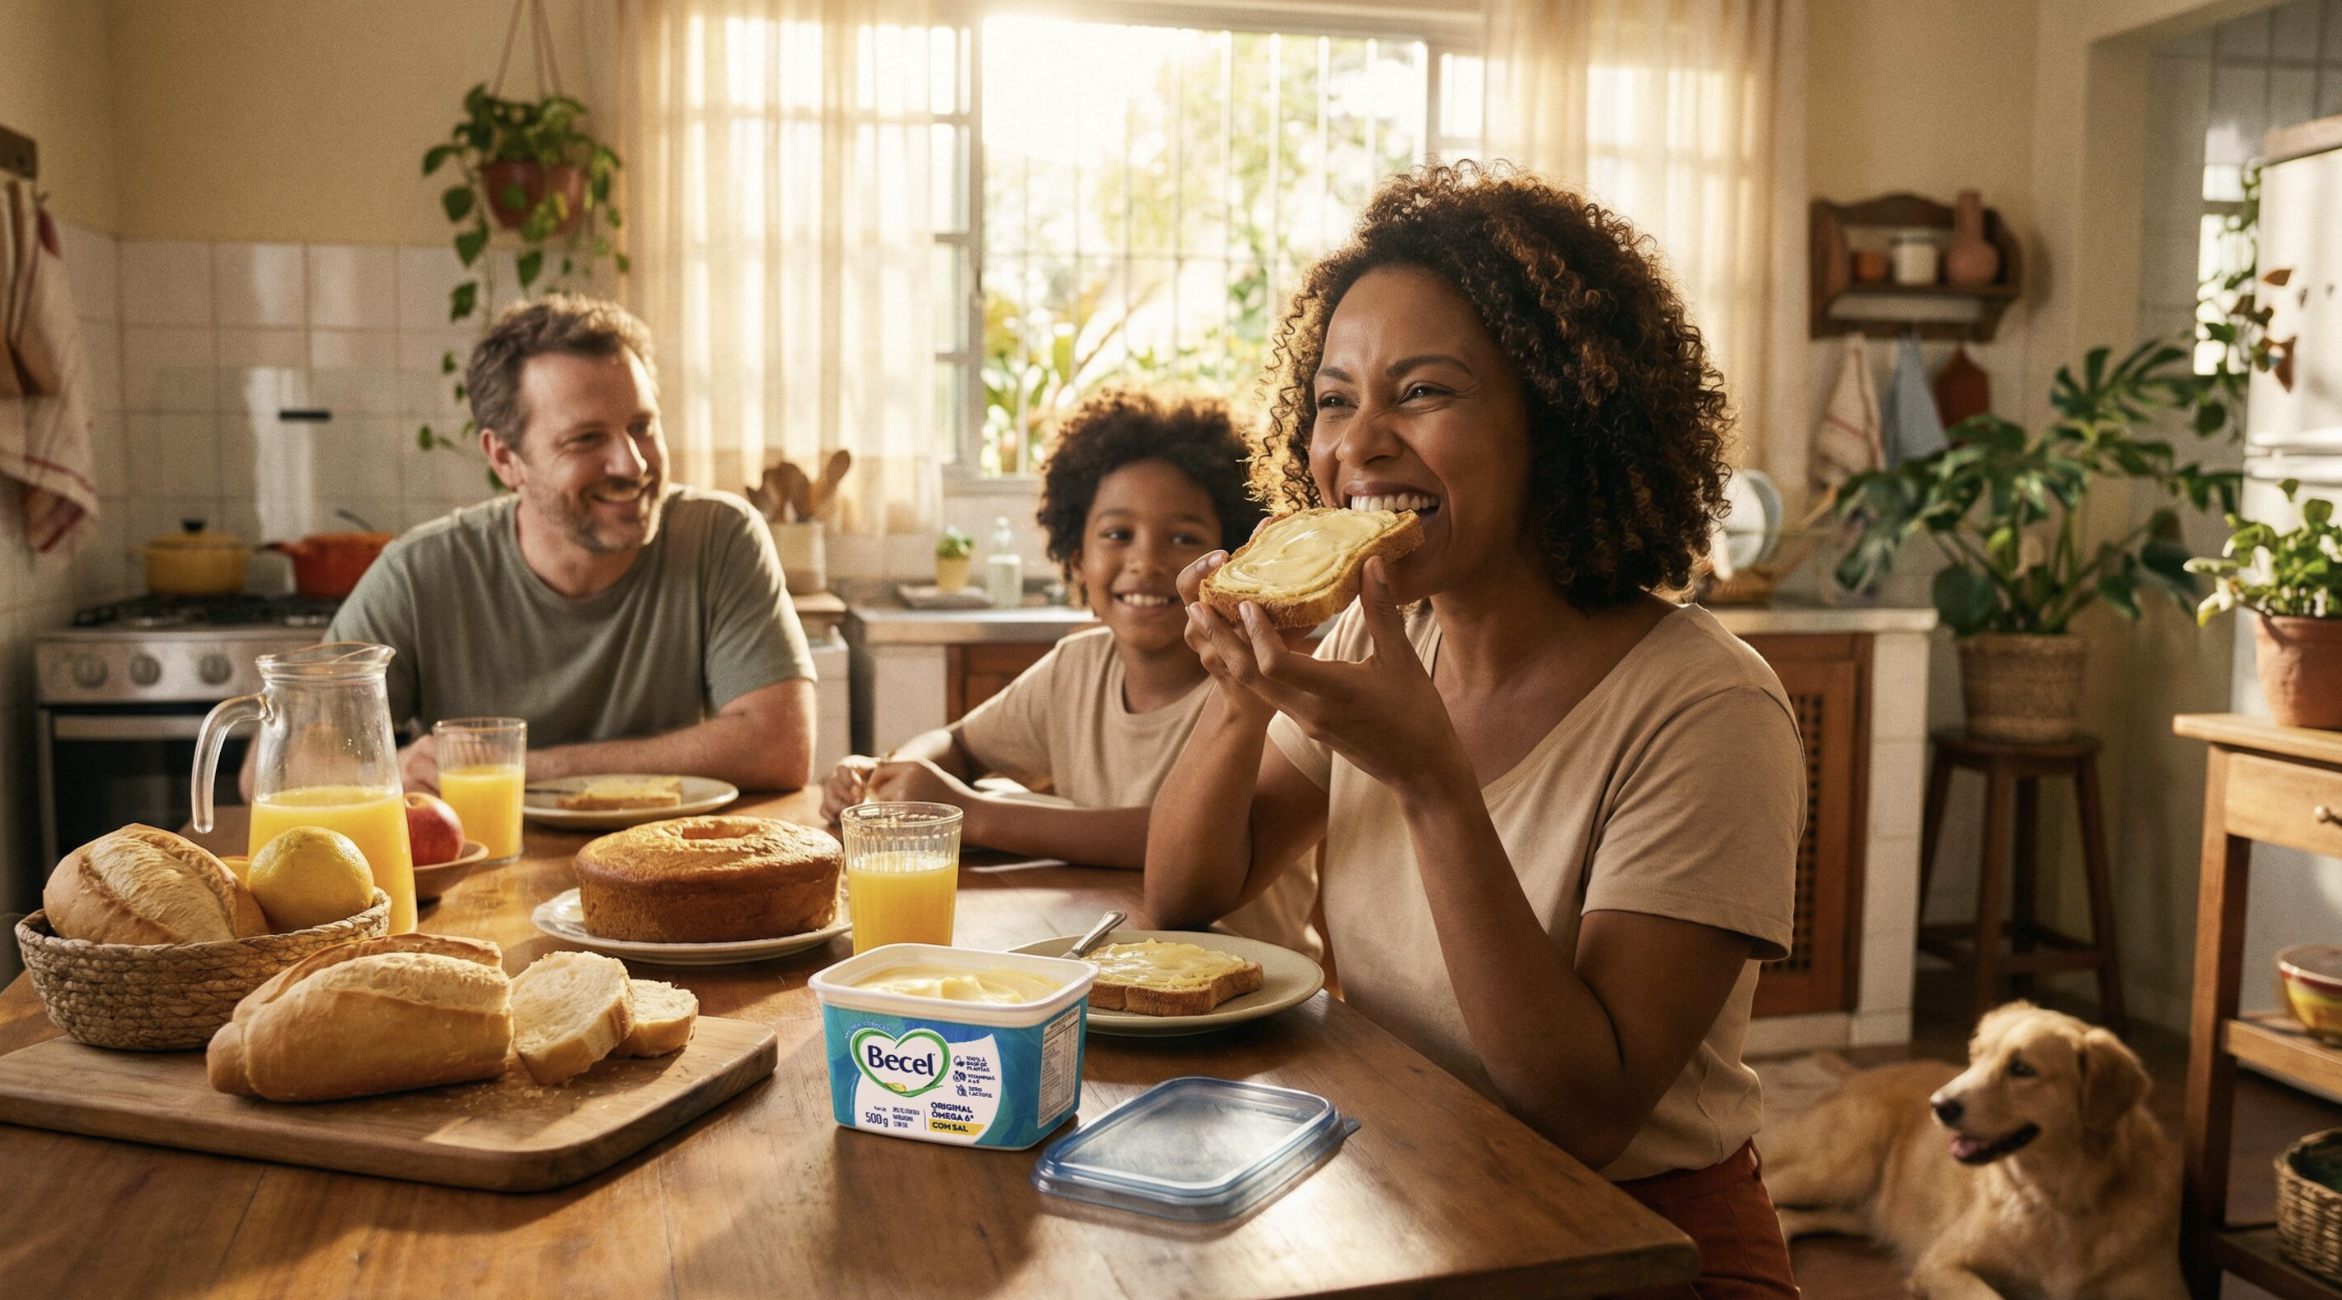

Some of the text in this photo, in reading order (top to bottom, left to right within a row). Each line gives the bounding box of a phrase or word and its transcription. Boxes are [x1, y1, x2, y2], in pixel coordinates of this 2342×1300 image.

[867, 1045, 934, 1076] Becel
[930, 1101, 973, 1113] ORIGINAL
[931, 1109, 963, 1121] ÔMEGA
[932, 1121, 969, 1132] COM SAL
